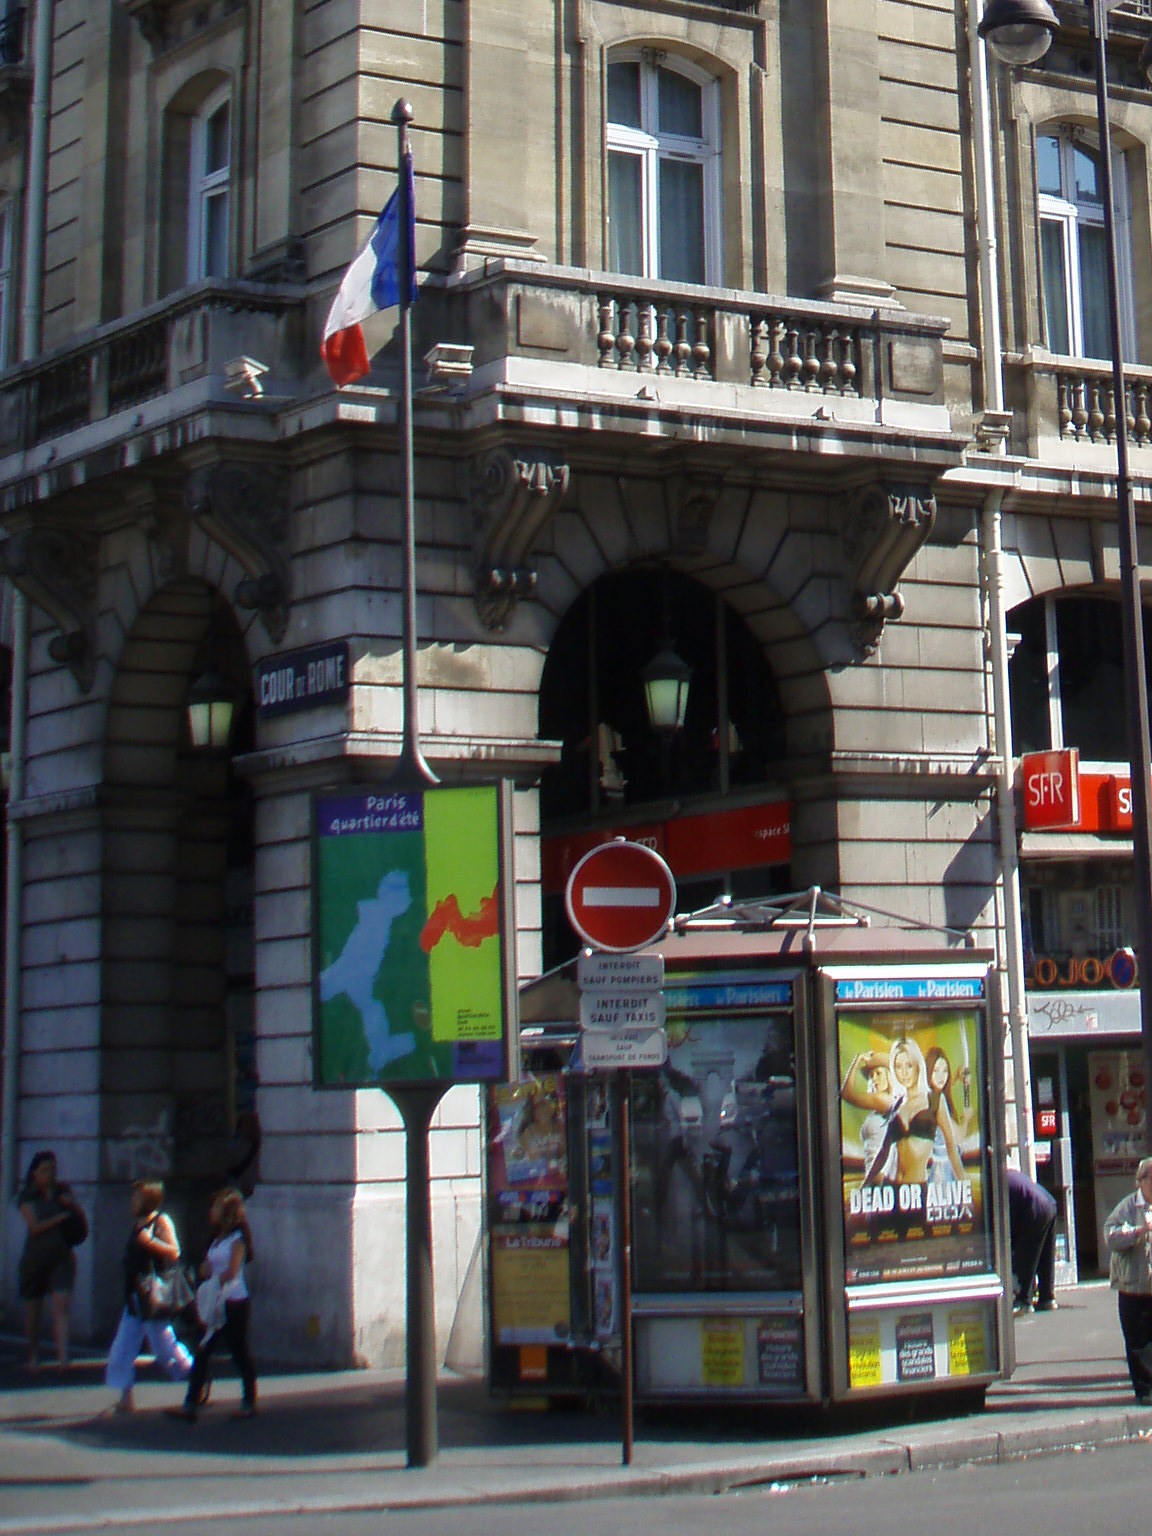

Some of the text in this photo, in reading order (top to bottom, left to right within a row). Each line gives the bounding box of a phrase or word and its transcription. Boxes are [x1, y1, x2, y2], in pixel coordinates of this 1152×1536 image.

[260, 666, 295, 706] COUR
[307, 654, 345, 696] ROME
[1027, 770, 1065, 807] SFR
[365, 792, 407, 812] Paris
[598, 960, 641, 971] INTERDIT
[583, 975, 659, 985] SAUF POMPIERS
[853, 979, 904, 999] Parisien
[926, 978, 974, 998] Parisien
[596, 997, 649, 1010] INTERDIT
[589, 1011, 657, 1024] SAUF TAXIS
[1040, 1114, 1056, 1127] SFR
[850, 1179, 973, 1215] DEAD OR ALIVE
